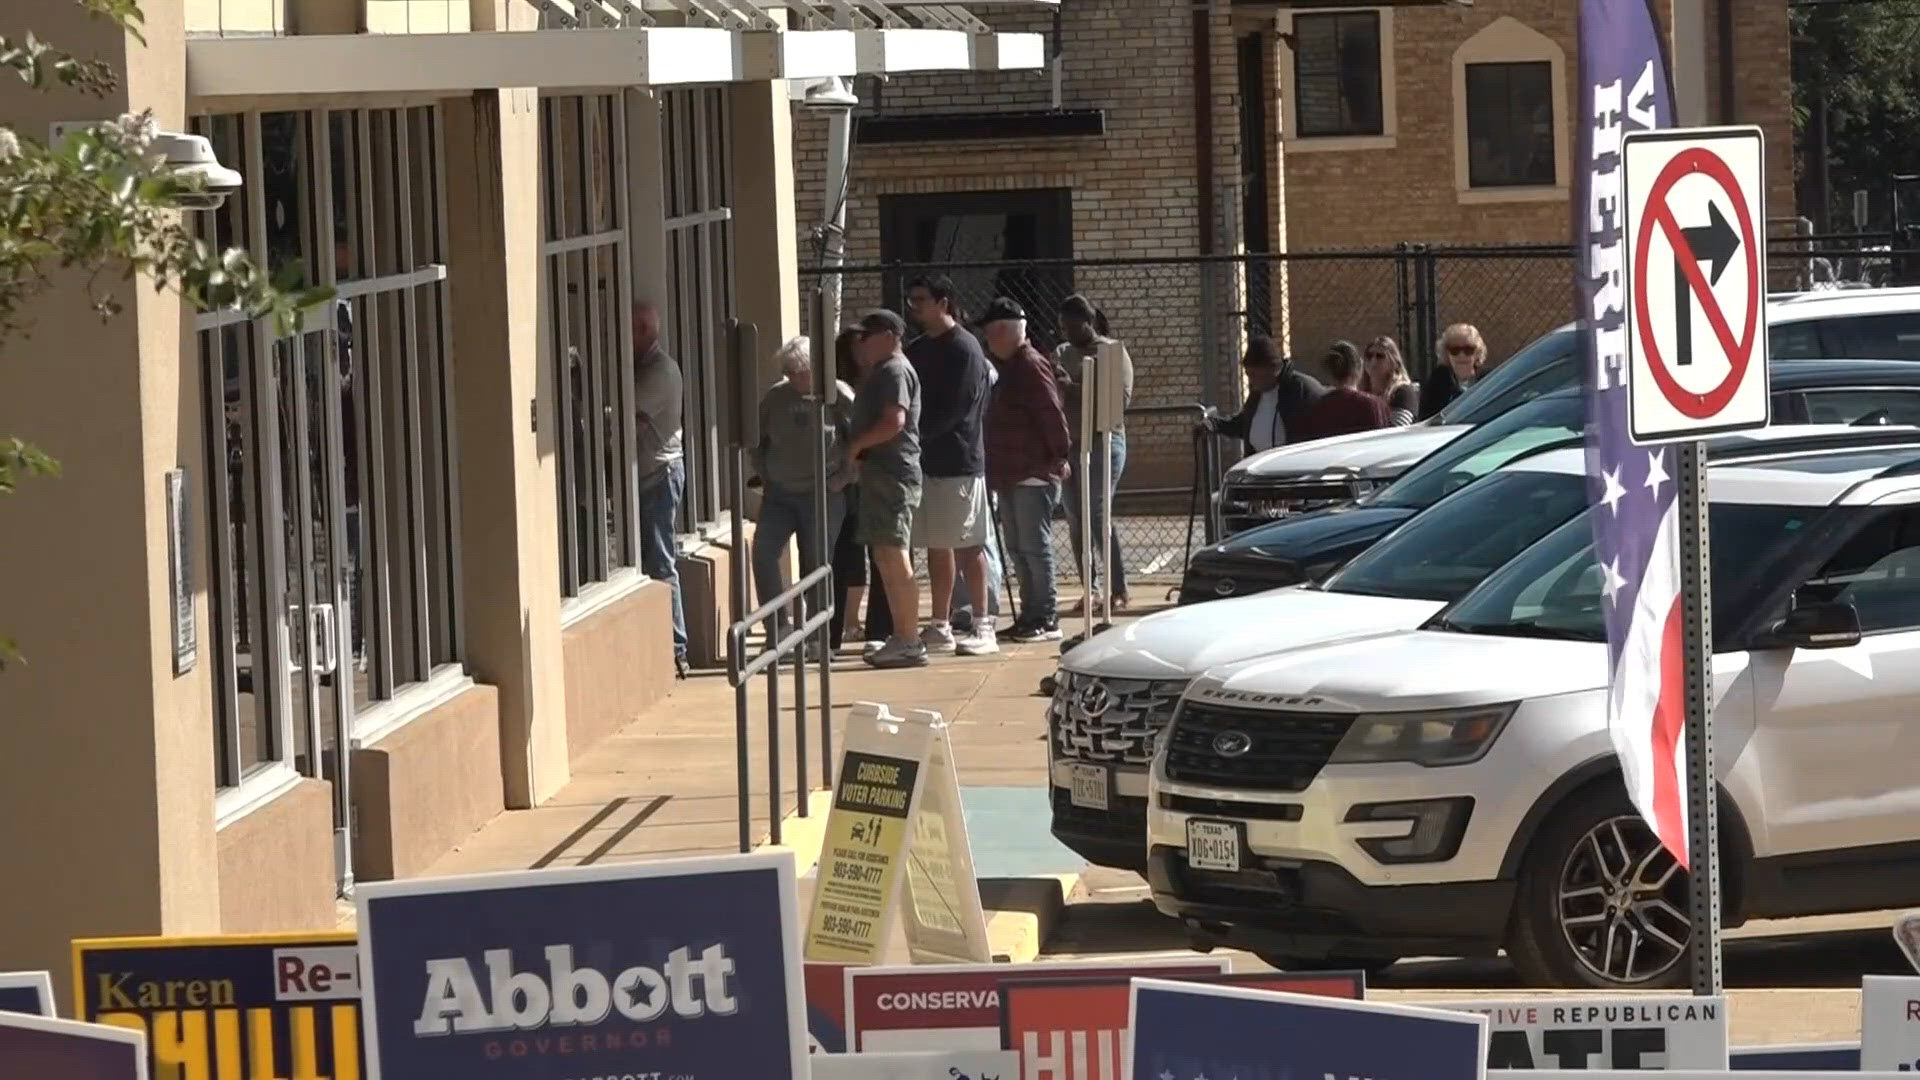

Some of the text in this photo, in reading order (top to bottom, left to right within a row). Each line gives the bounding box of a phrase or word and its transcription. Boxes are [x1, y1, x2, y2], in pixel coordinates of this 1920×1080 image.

[1591, 77, 1627, 391] HERE
[857, 762, 900, 785] CURBSIDE
[841, 782, 907, 810] VOTER PARKING
[1202, 824, 1222, 835] TEXAS
[95, 971, 235, 1009] Karen
[414, 943, 737, 1037] Abbott
[1553, 1004, 1716, 1024] REPUBLICAN
[484, 1026, 672, 1058] GOVERNOR
